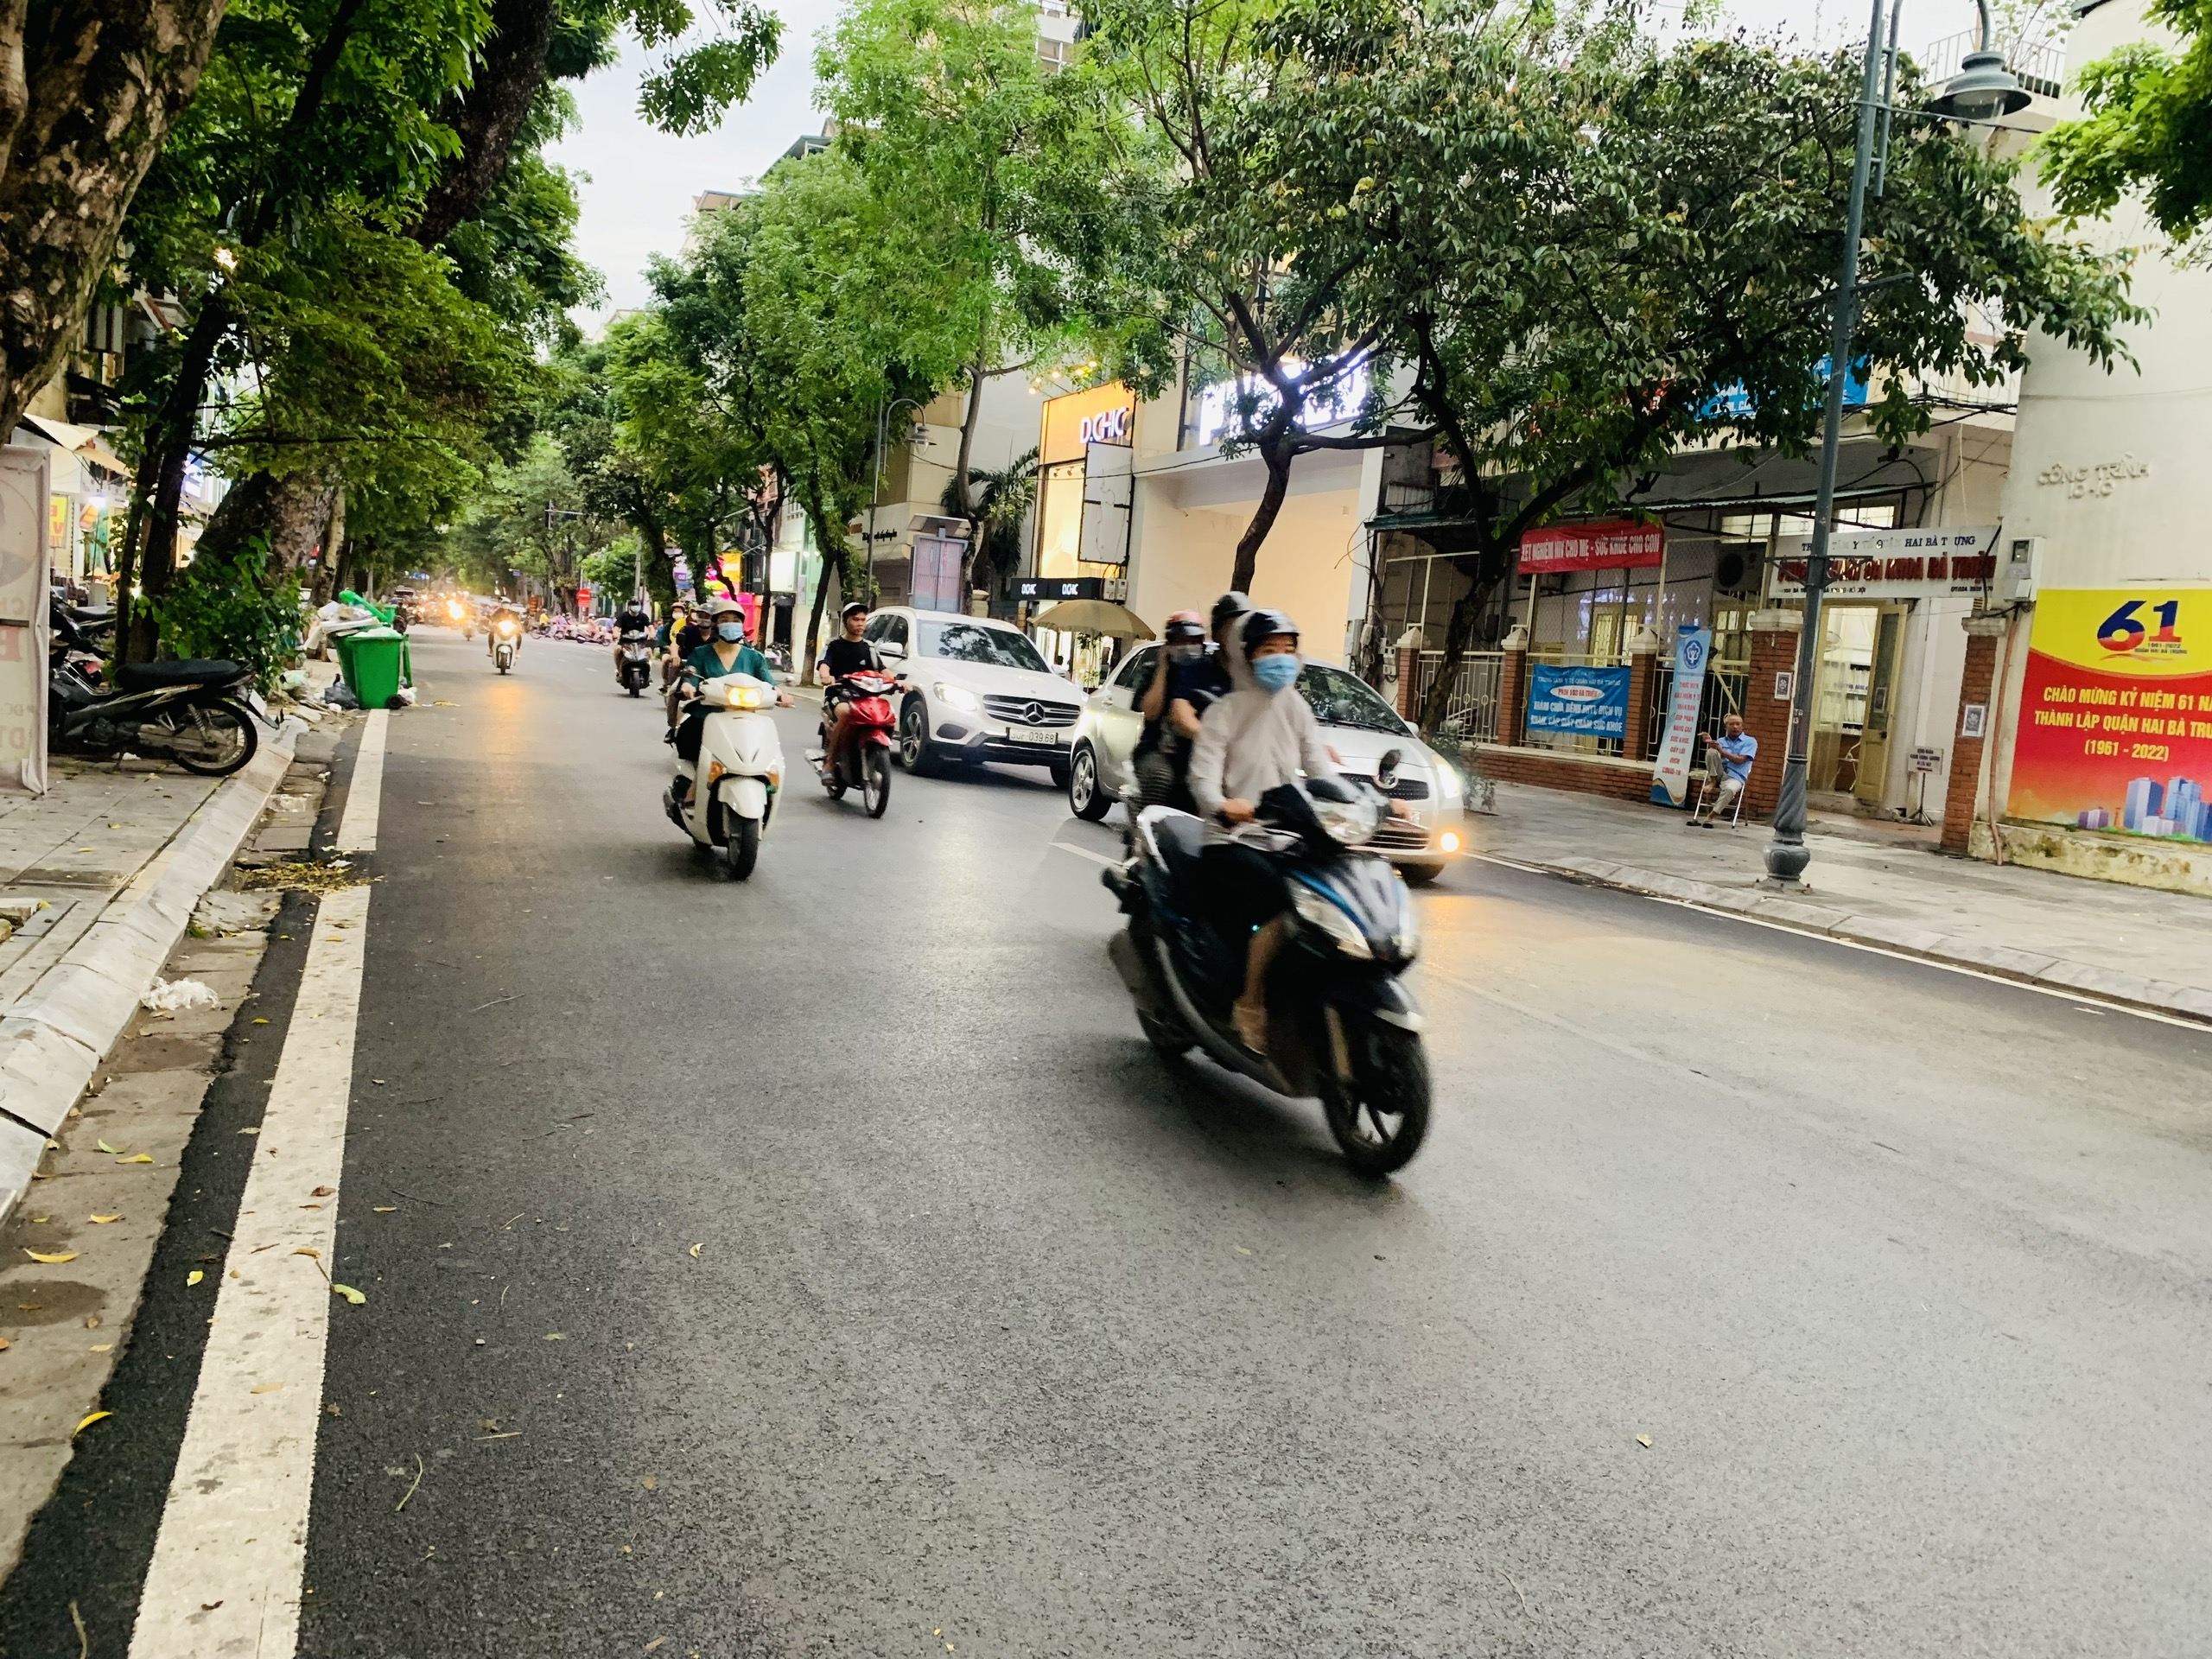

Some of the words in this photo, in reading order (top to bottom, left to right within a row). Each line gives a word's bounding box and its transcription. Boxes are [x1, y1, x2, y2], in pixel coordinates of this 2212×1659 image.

[1080, 406, 1128, 443] D.CHIC
[1565, 539, 1579, 558] CHO
[1579, 538, 1590, 562] MẸ
[1594, 533, 1610, 556] SỨC
[1628, 534, 1643, 554] CHO
[1644, 533, 1660, 553] CON
[1904, 537, 1923, 547] HAI
[1925, 535, 1938, 547] BÀ
[2097, 601, 2182, 652] 61
[2044, 684, 2076, 703] CHÀO
[2079, 686, 2118, 706] MỪNG
[2120, 686, 2138, 707] KỶ
[2139, 690, 2175, 712] NIỆM
[2177, 695, 2195, 711] 61
[2035, 709, 2074, 727] THÀNH
[2076, 714, 2100, 731] LẬP
[2103, 714, 2139, 734] QUẬN
[2141, 717, 2164, 735] HAI
[2167, 717, 2185, 737] BÀ
[2085, 739, 2119, 757] (1961
[2132, 743, 2170, 762] 2022)
